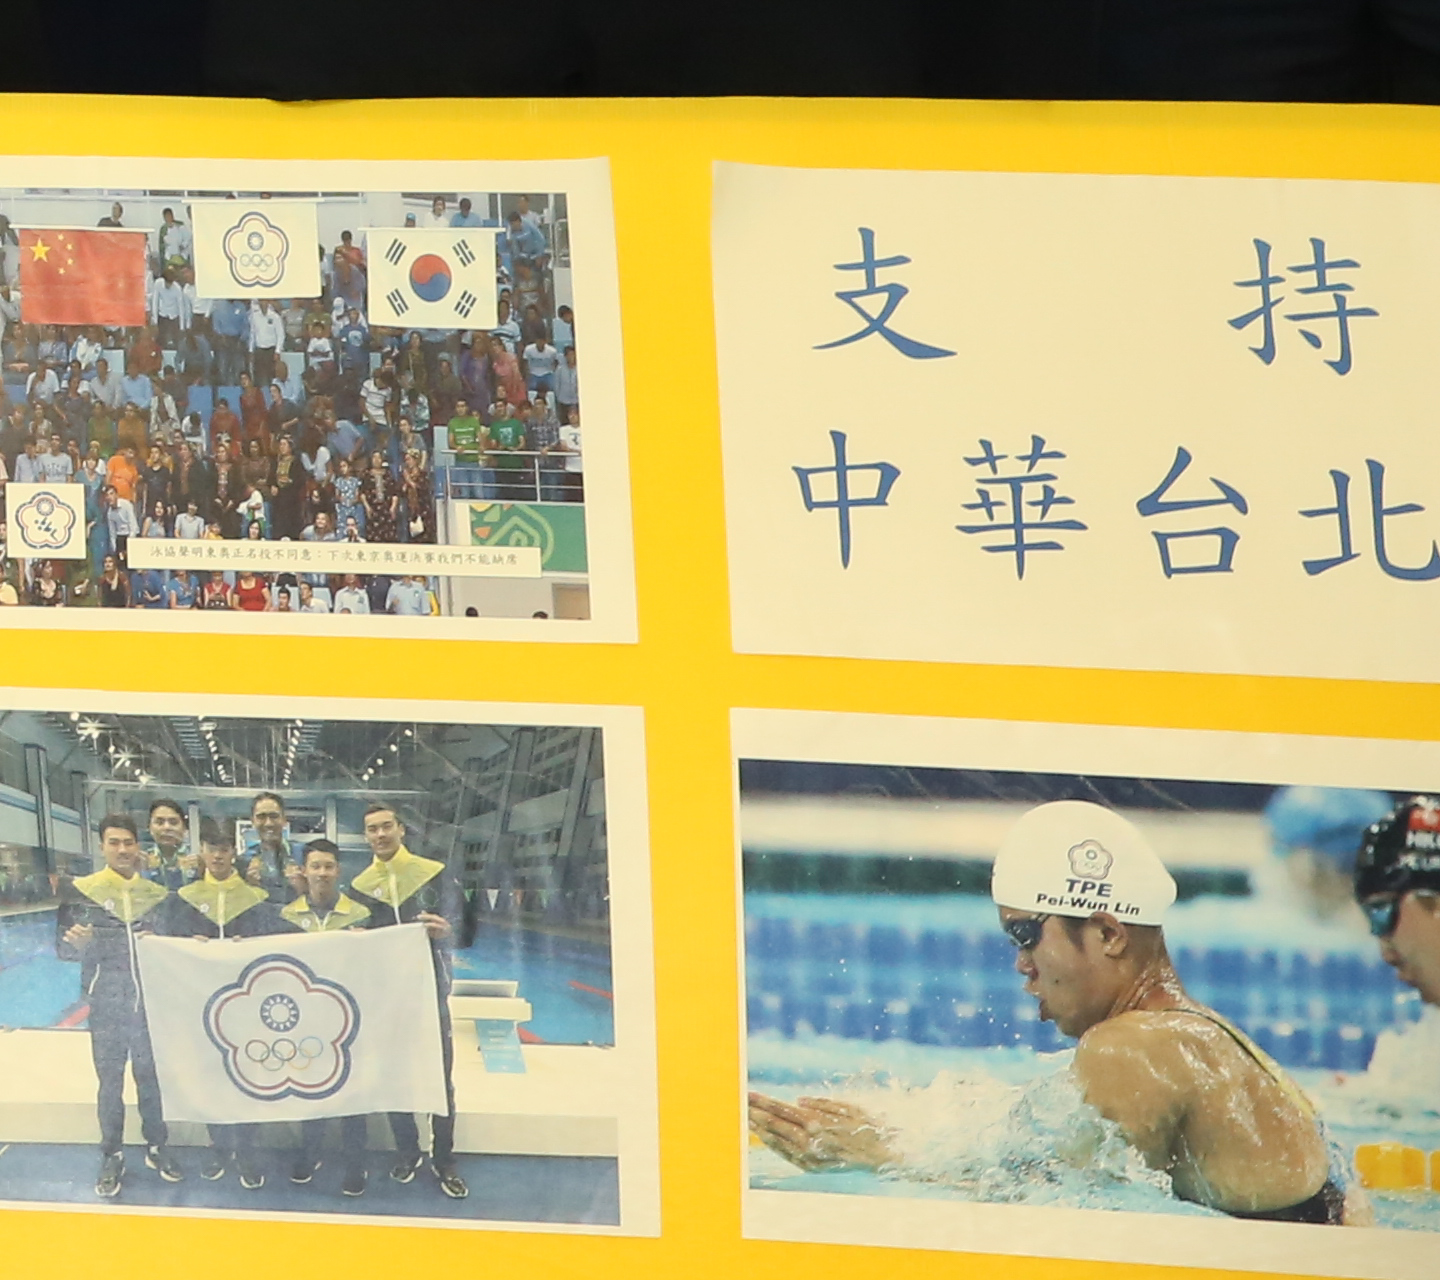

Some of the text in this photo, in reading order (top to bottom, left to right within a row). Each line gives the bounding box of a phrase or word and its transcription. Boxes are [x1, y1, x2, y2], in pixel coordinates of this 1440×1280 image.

[812, 227, 1380, 376] 支持
[792, 430, 1440, 581] 中華台北
[1036, 893, 1140, 916] Pei-Wun Lin
[1066, 878, 1113, 898] TPE
